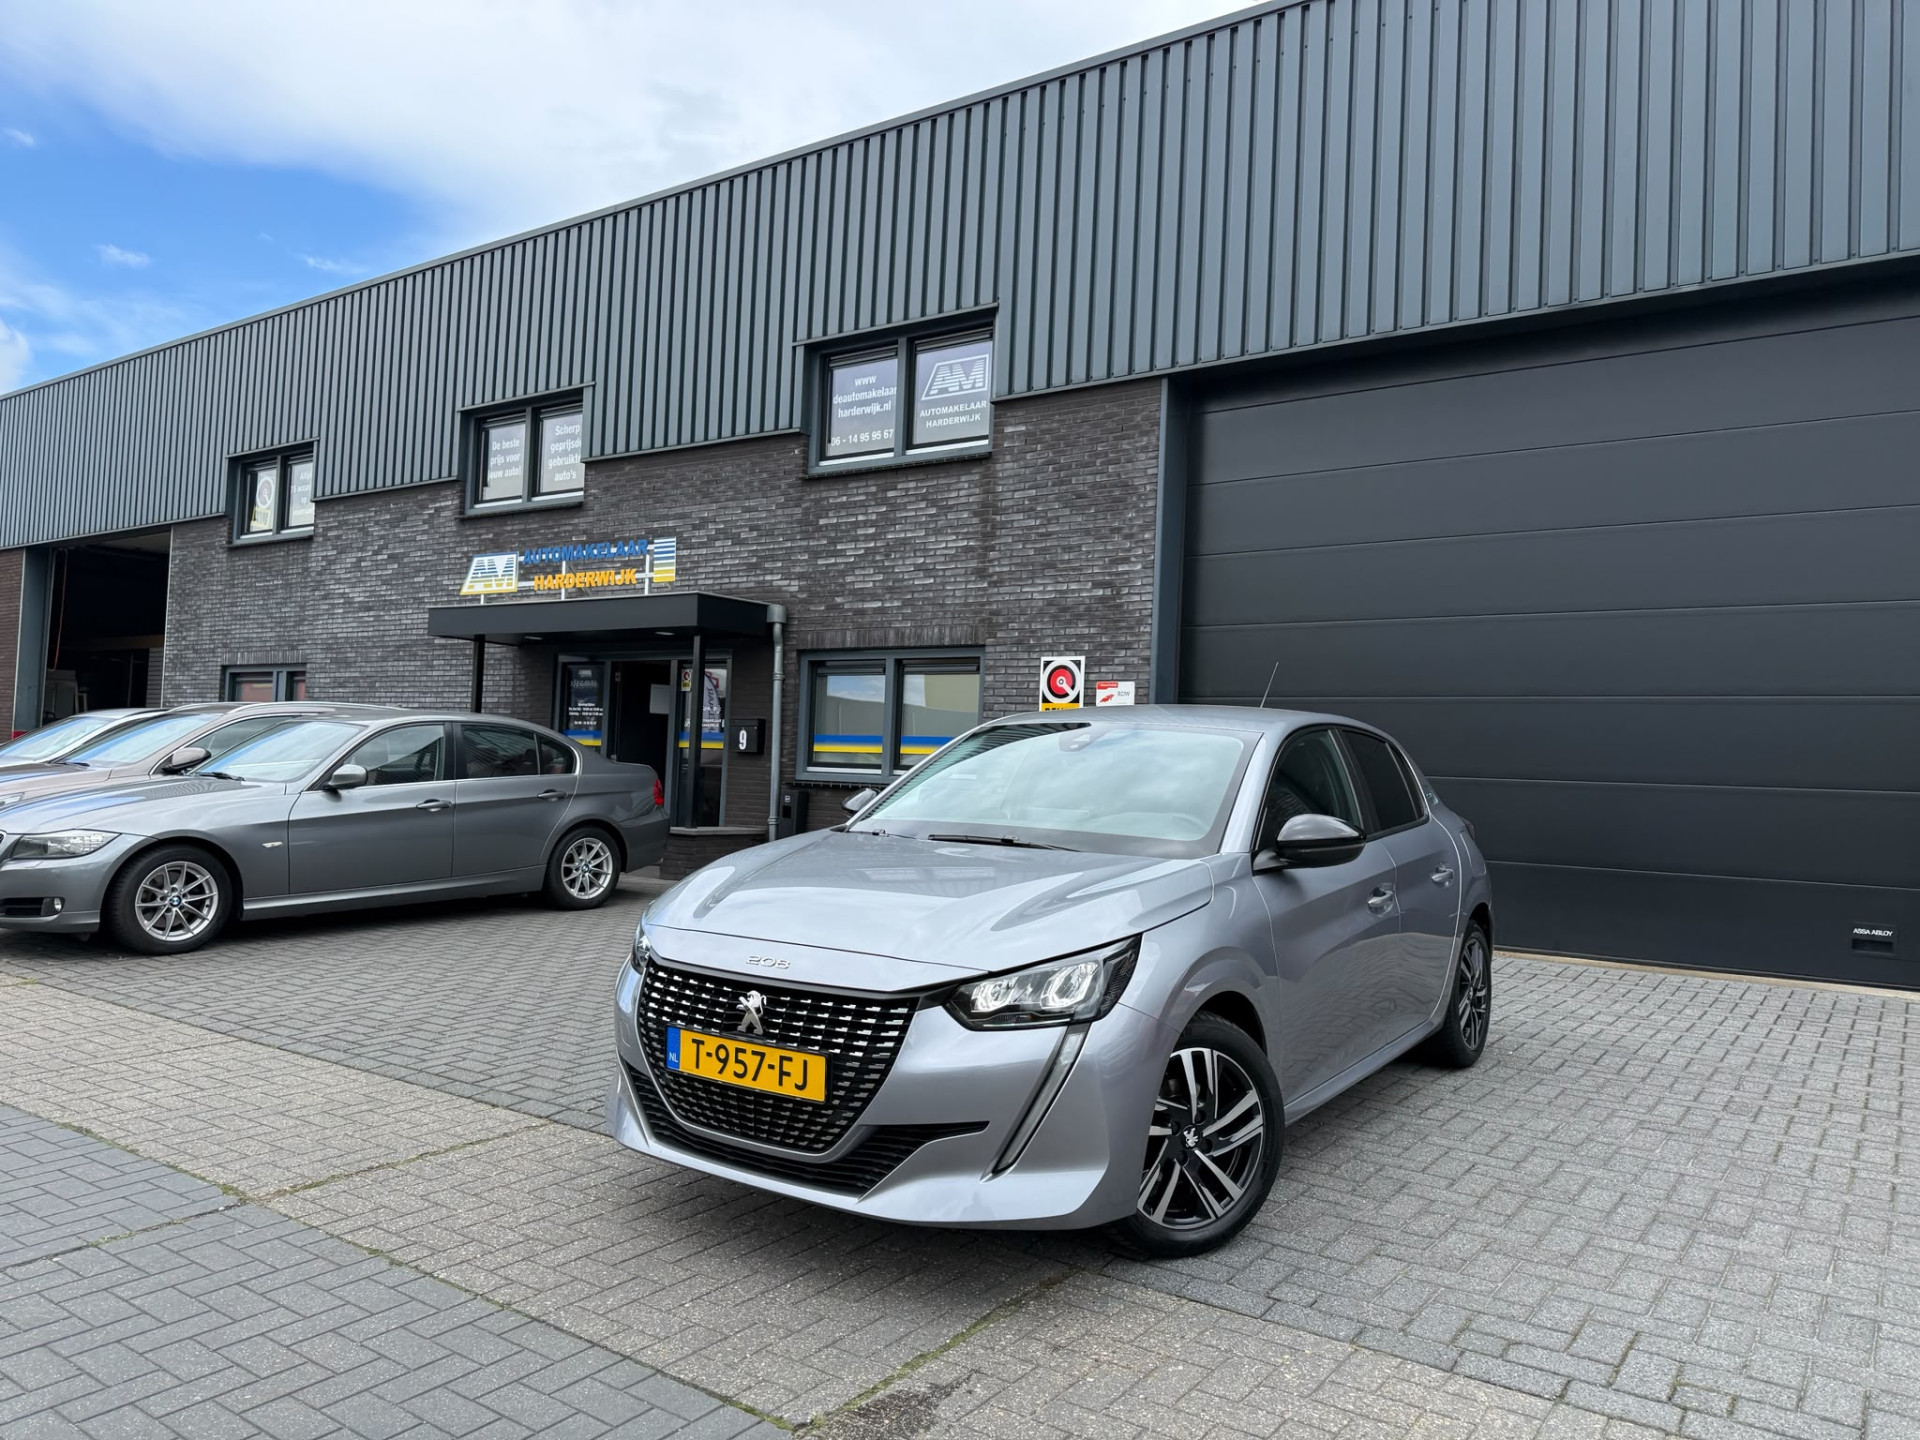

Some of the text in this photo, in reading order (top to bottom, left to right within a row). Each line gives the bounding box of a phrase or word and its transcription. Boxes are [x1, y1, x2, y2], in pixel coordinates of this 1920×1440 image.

[854, 375, 877, 387] www
[833, 386, 898, 405] deautomakelaar
[838, 401, 892, 419] harderwijk.nl
[919, 400, 987, 418] AUTOMAKELAAR
[926, 413, 981, 429] HARDERWIJK
[555, 424, 581, 436] Scherp
[831, 436, 841, 446] 06
[849, 433, 858, 445] 14
[859, 432, 870, 443] 95
[871, 430, 882, 441] 95
[883, 429, 894, 440] 67
[492, 439, 520, 451] De beste
[550, 438, 581, 454] geprijsd
[490, 453, 521, 467] prijs voor
[554, 470, 577, 481] auto's
[522, 539, 649, 565] AUTOMAKELAAR
[533, 569, 638, 590] HARDERWIJK
[739, 730, 748, 750] 9
[745, 955, 791, 970] 208
[668, 1049, 679, 1064] NL
[691, 1038, 808, 1091] T-957-FJ
